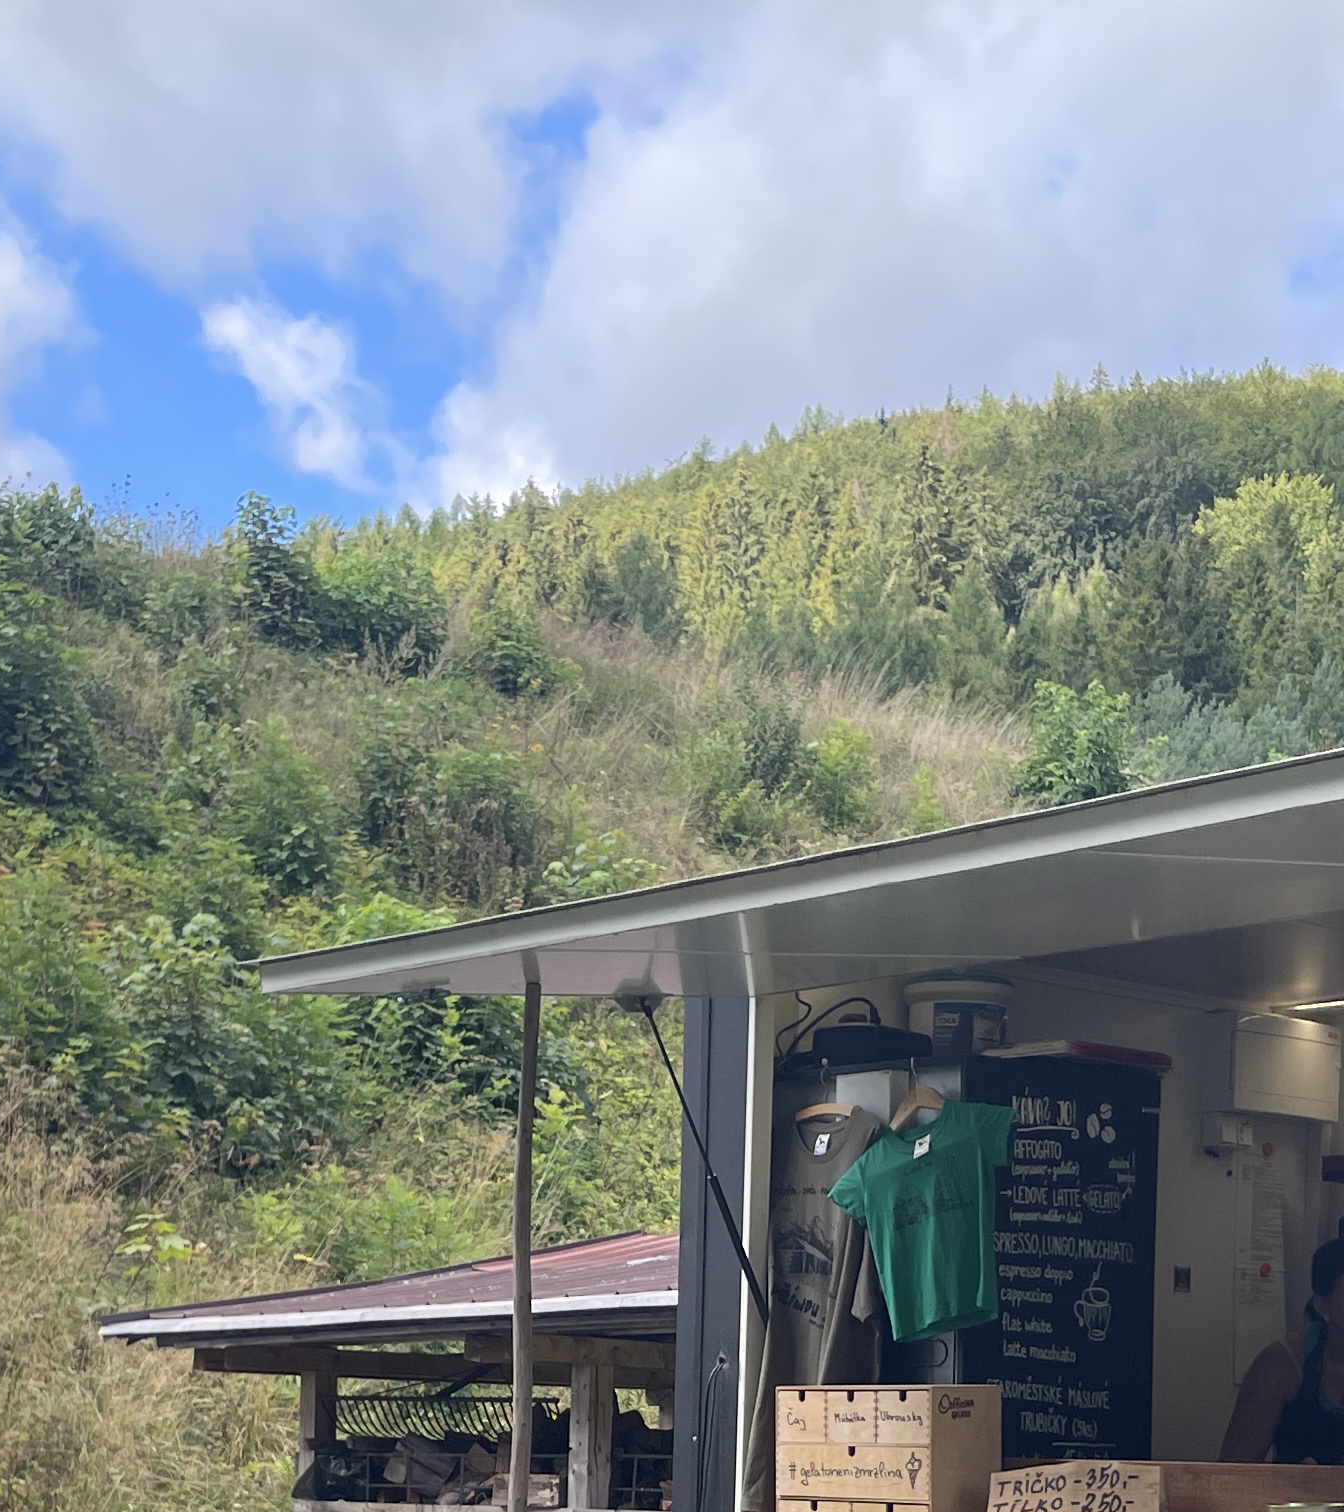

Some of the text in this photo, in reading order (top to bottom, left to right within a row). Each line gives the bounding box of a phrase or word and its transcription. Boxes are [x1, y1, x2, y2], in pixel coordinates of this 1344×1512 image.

[1014, 1138, 1062, 1159] AFFOGATO
[1012, 1179, 1048, 1205] LEDOVÉ
[999, 1263, 1073, 1286] espresso doppio
[1000, 1288, 1053, 1307] cappuccino
[1002, 1312, 1053, 1334] flat white
[1029, 1345, 1076, 1362] macchiato
[1068, 1380, 1111, 1410] MÁSLOVÉ
[787, 1407, 806, 1431] Čaj
[1019, 1407, 1068, 1436] TRUBIČKY
